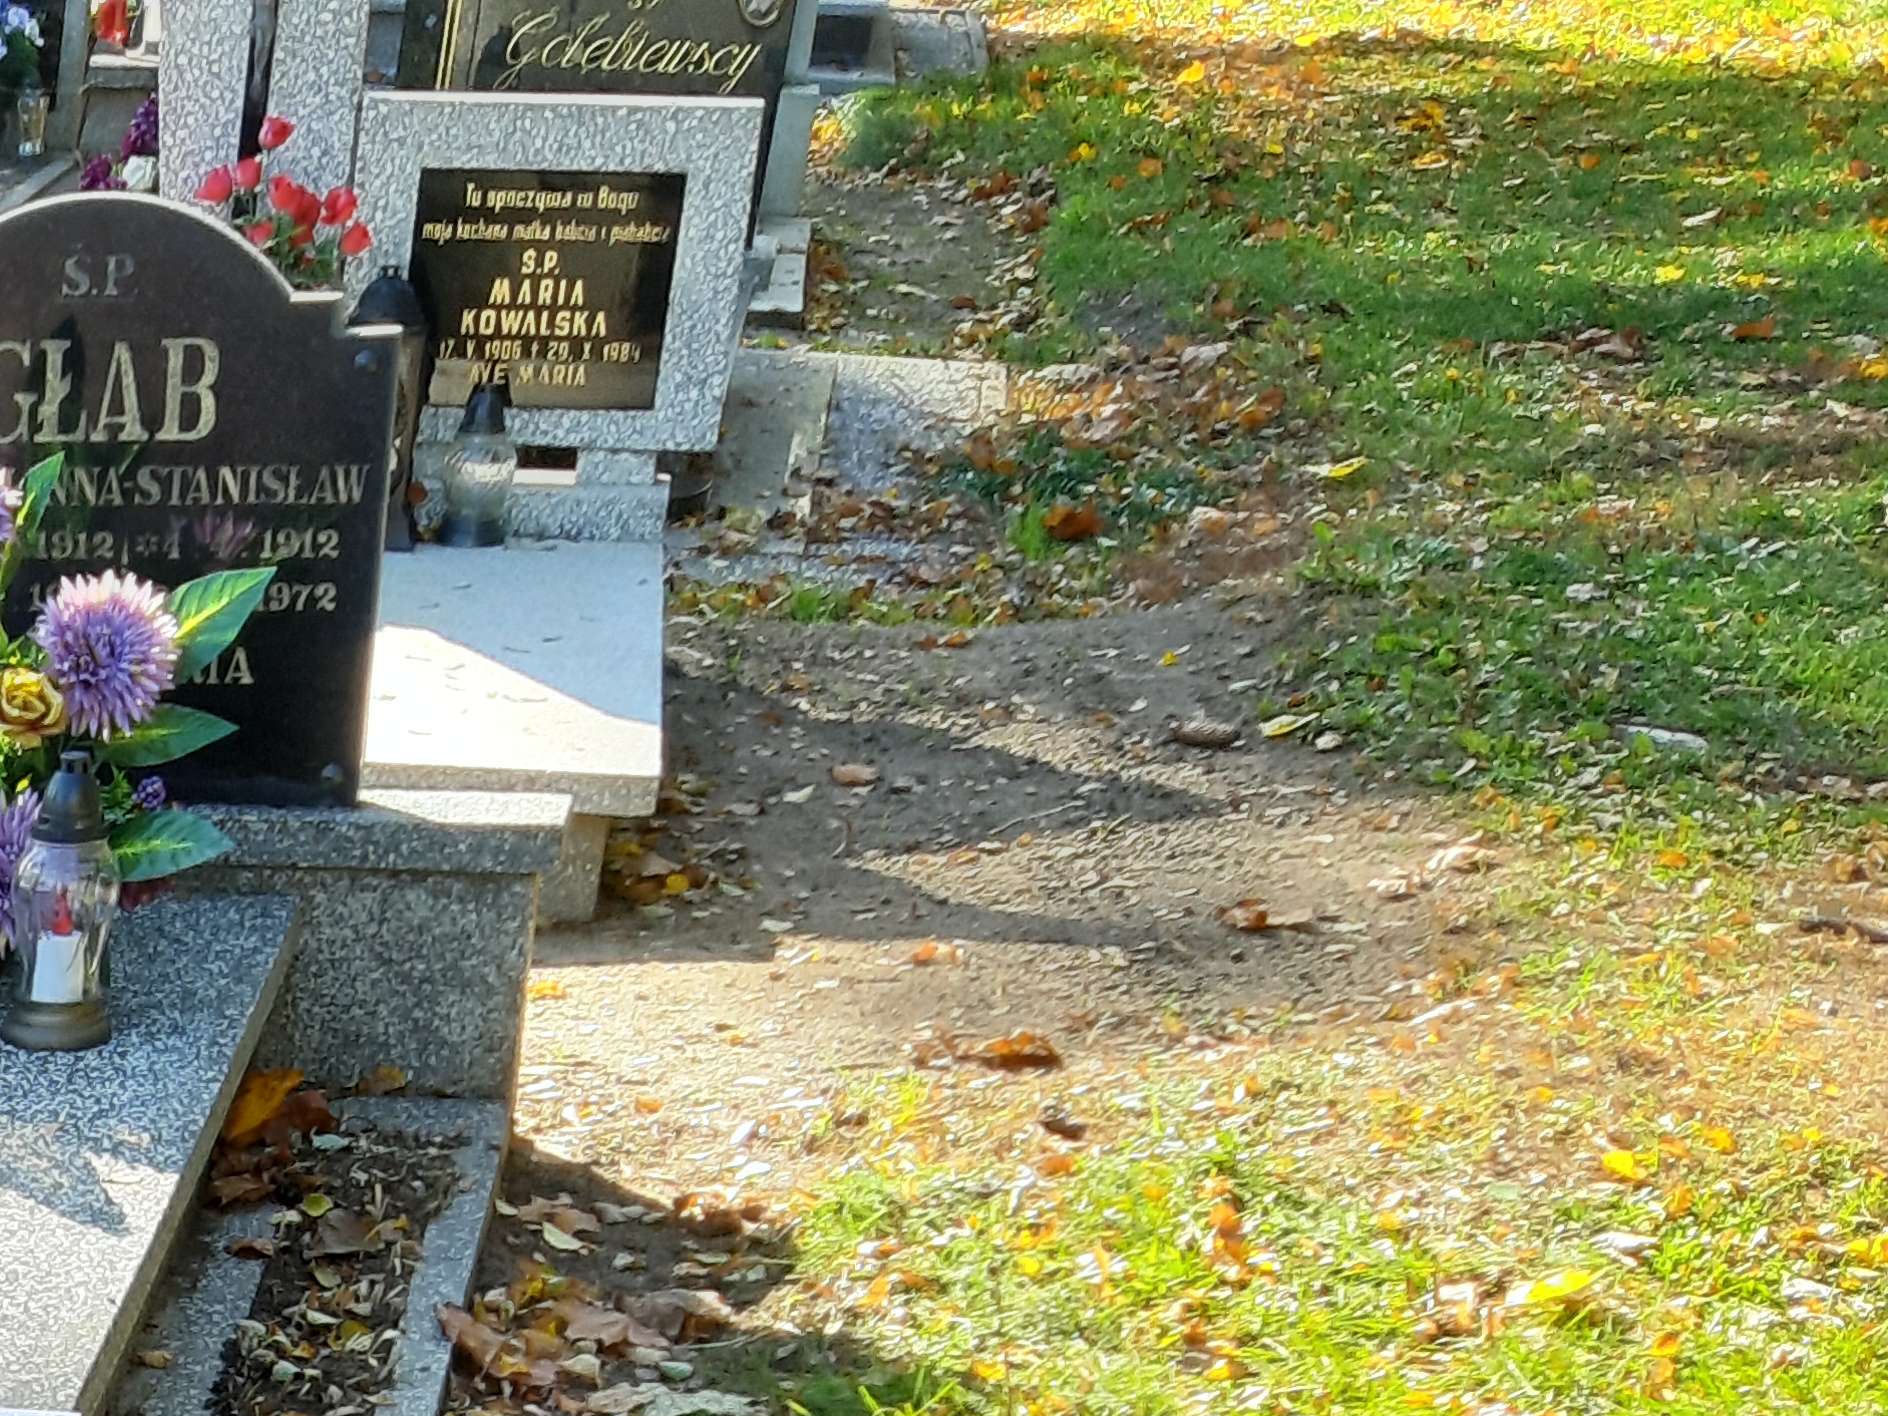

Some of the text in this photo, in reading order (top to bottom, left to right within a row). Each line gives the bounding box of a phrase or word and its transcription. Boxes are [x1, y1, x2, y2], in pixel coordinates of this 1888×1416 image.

[487, 276, 585, 307] MARIA
[459, 307, 607, 338] KOWALSKA
[515, 363, 587, 387] MARIA
[46, 463, 370, 505] NNA-STANISŁAW
[258, 526, 342, 560] 1912
